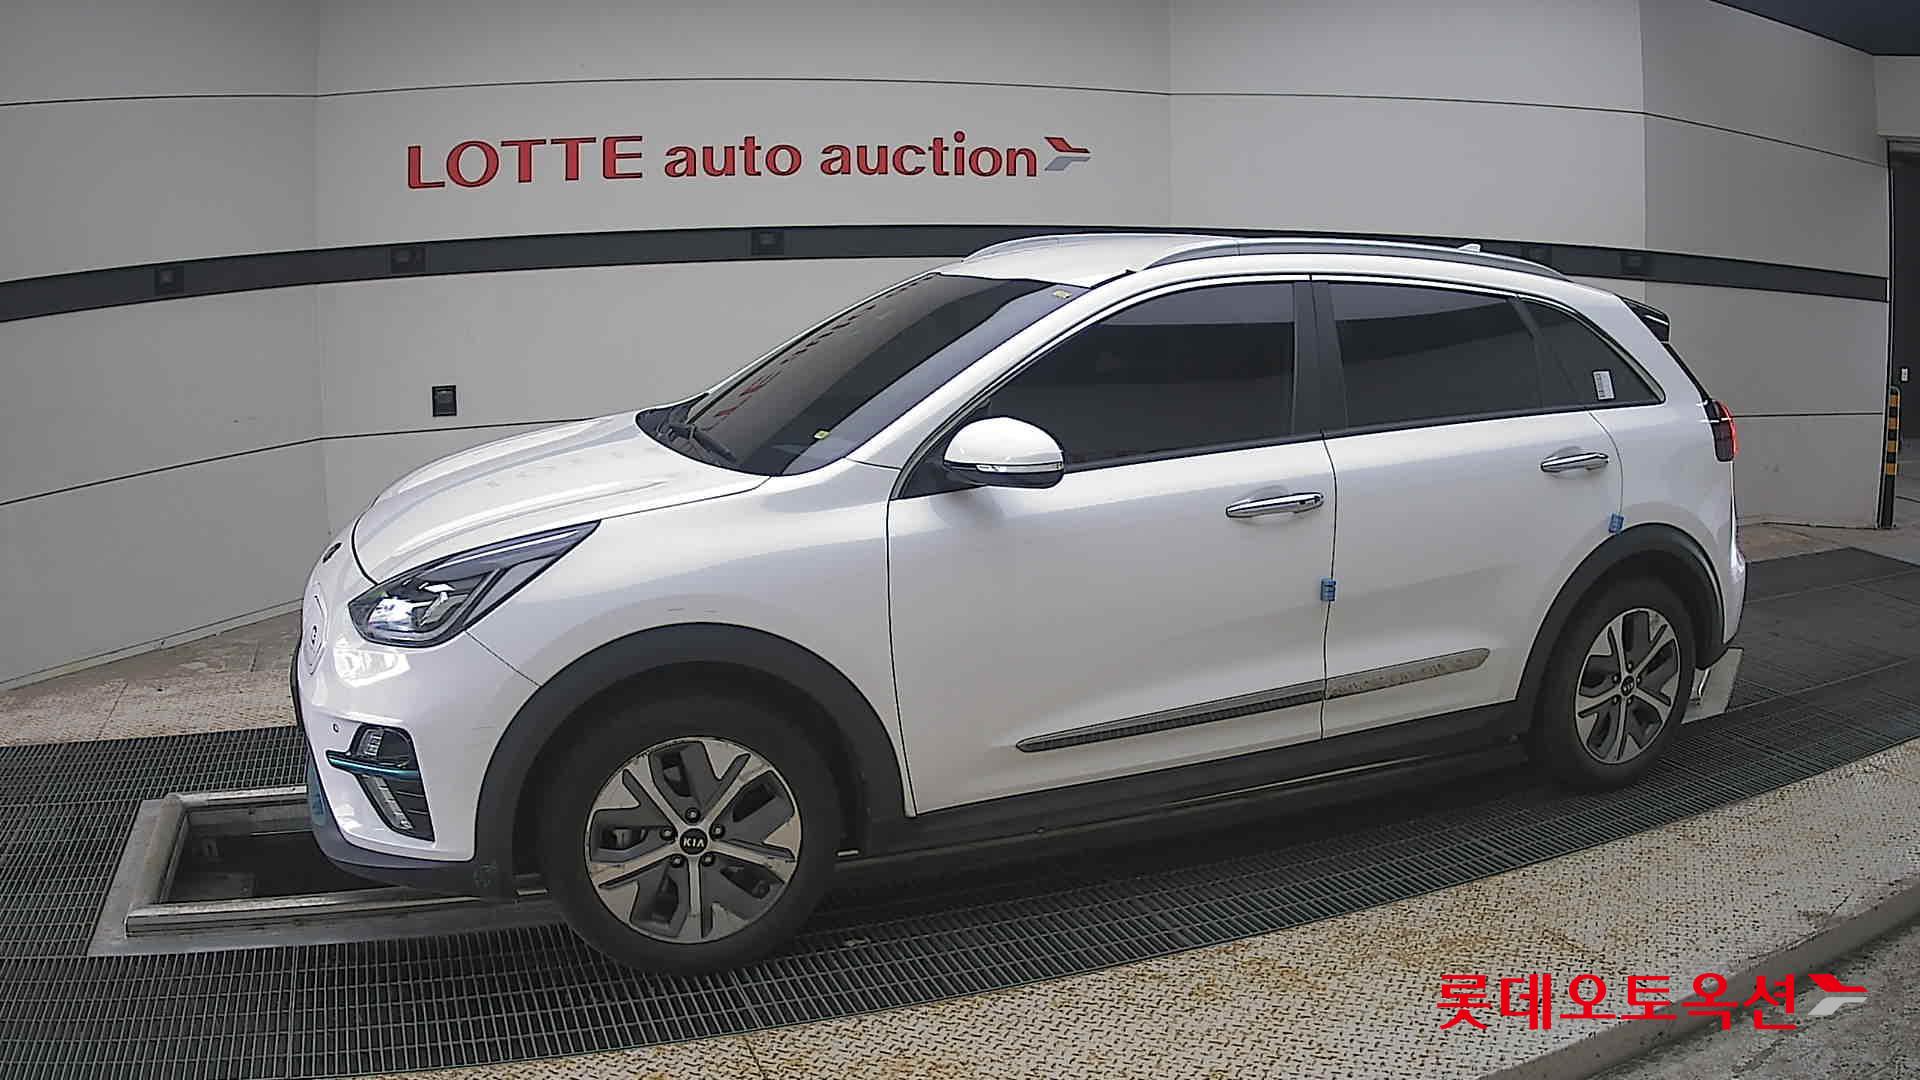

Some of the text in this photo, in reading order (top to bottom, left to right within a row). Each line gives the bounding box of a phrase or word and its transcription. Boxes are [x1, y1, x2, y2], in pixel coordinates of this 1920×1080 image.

[407, 130, 1038, 189] LOTTE auto auction
[683, 837, 705, 848] KIA
